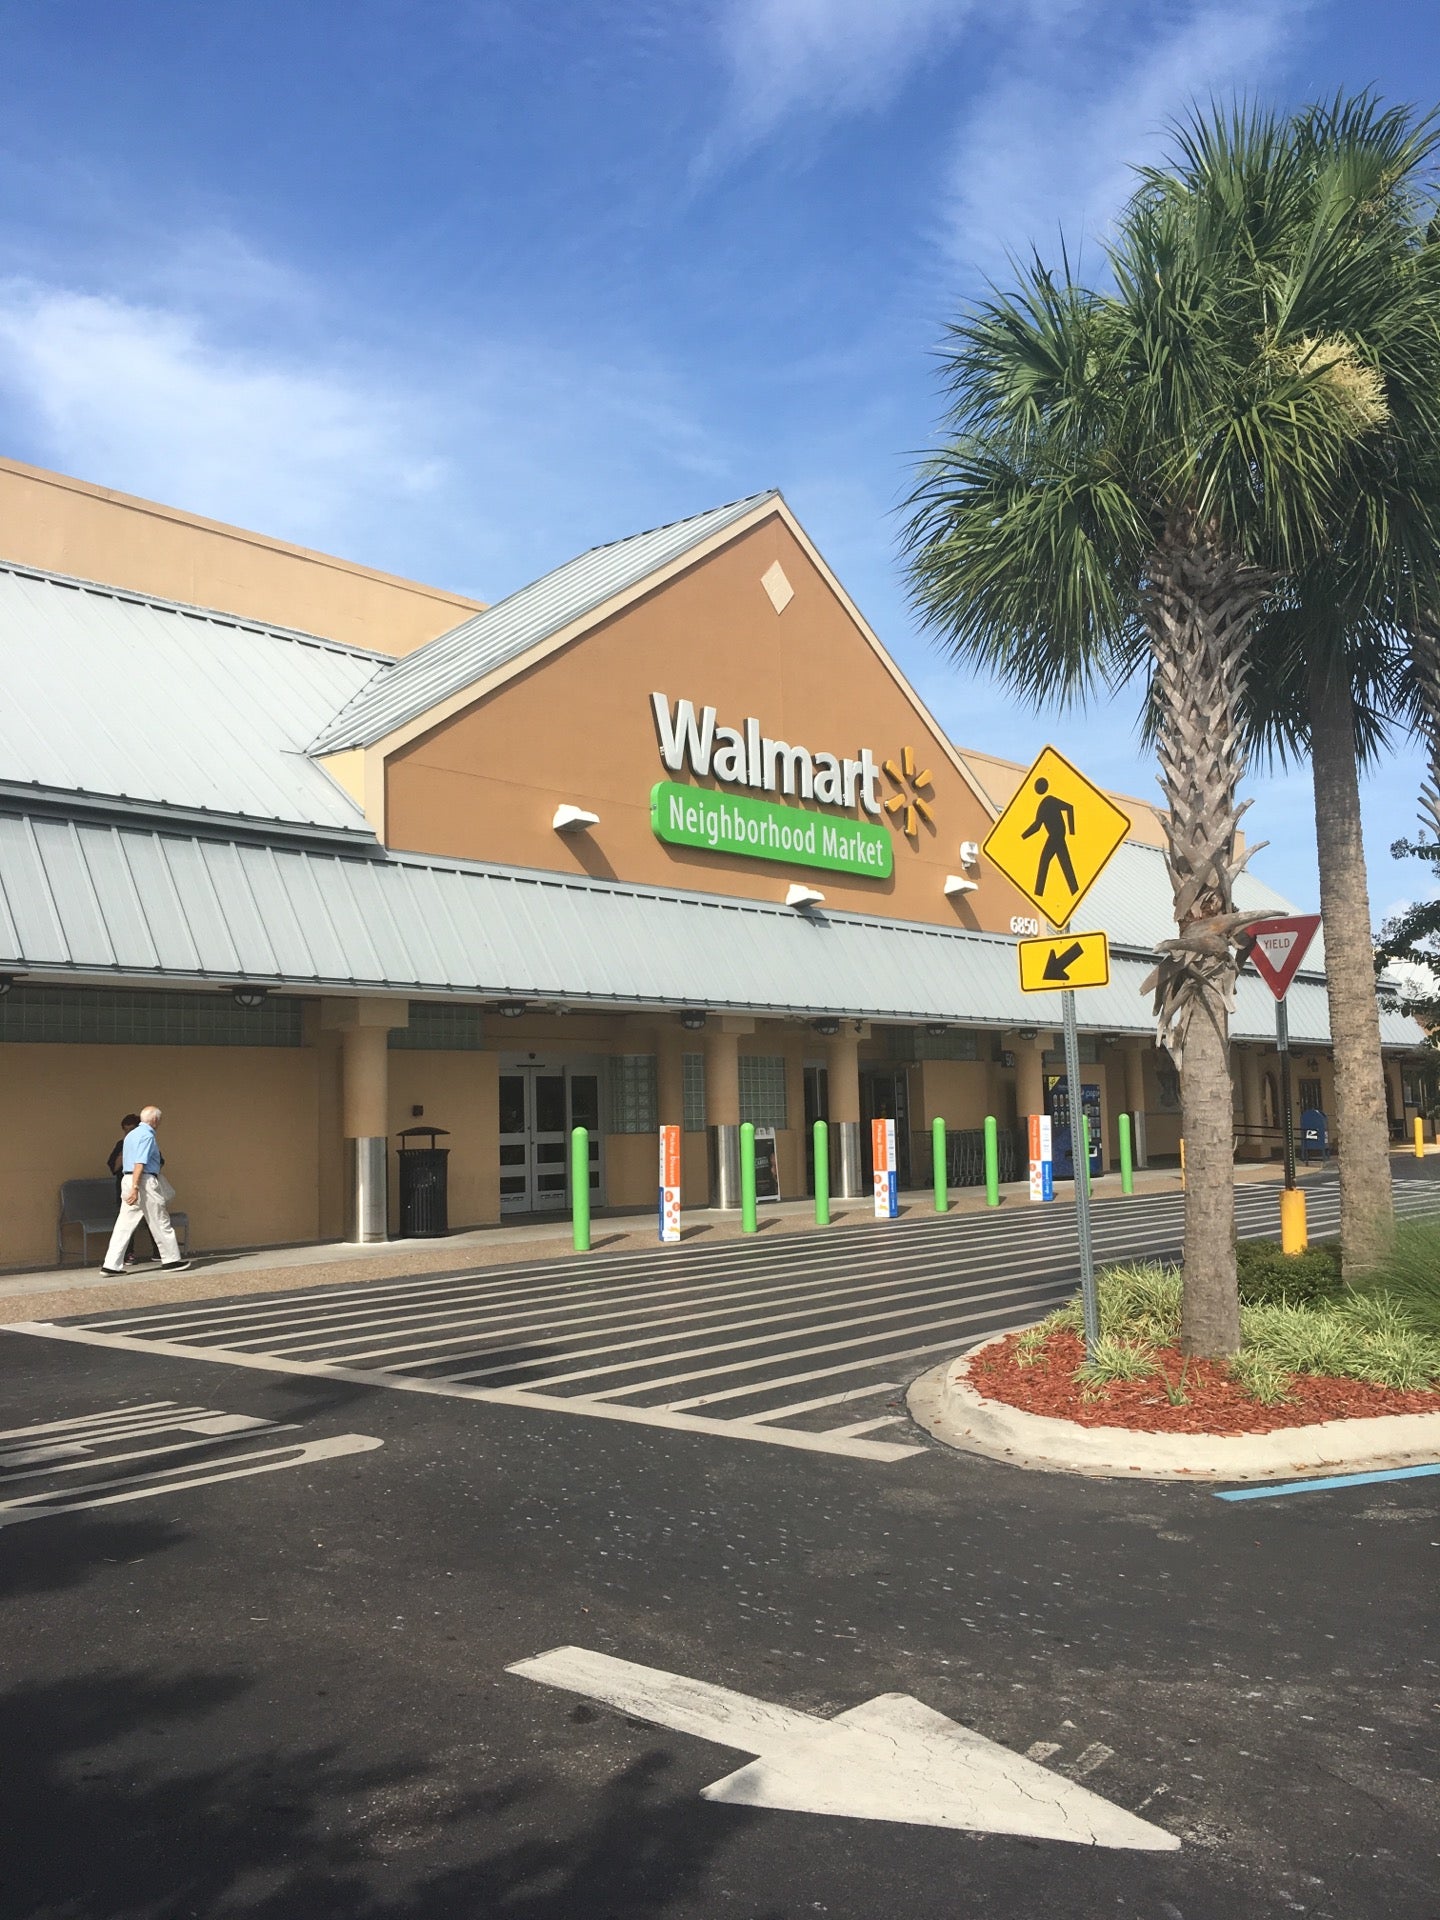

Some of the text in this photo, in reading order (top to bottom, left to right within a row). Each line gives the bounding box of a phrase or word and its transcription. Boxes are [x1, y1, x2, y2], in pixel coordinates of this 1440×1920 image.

[651, 691, 881, 814] Walmart
[668, 795, 885, 867] Neighborhood Market
[1010, 916, 1038, 935] 6850
[1263, 938, 1290, 949] YIELD
